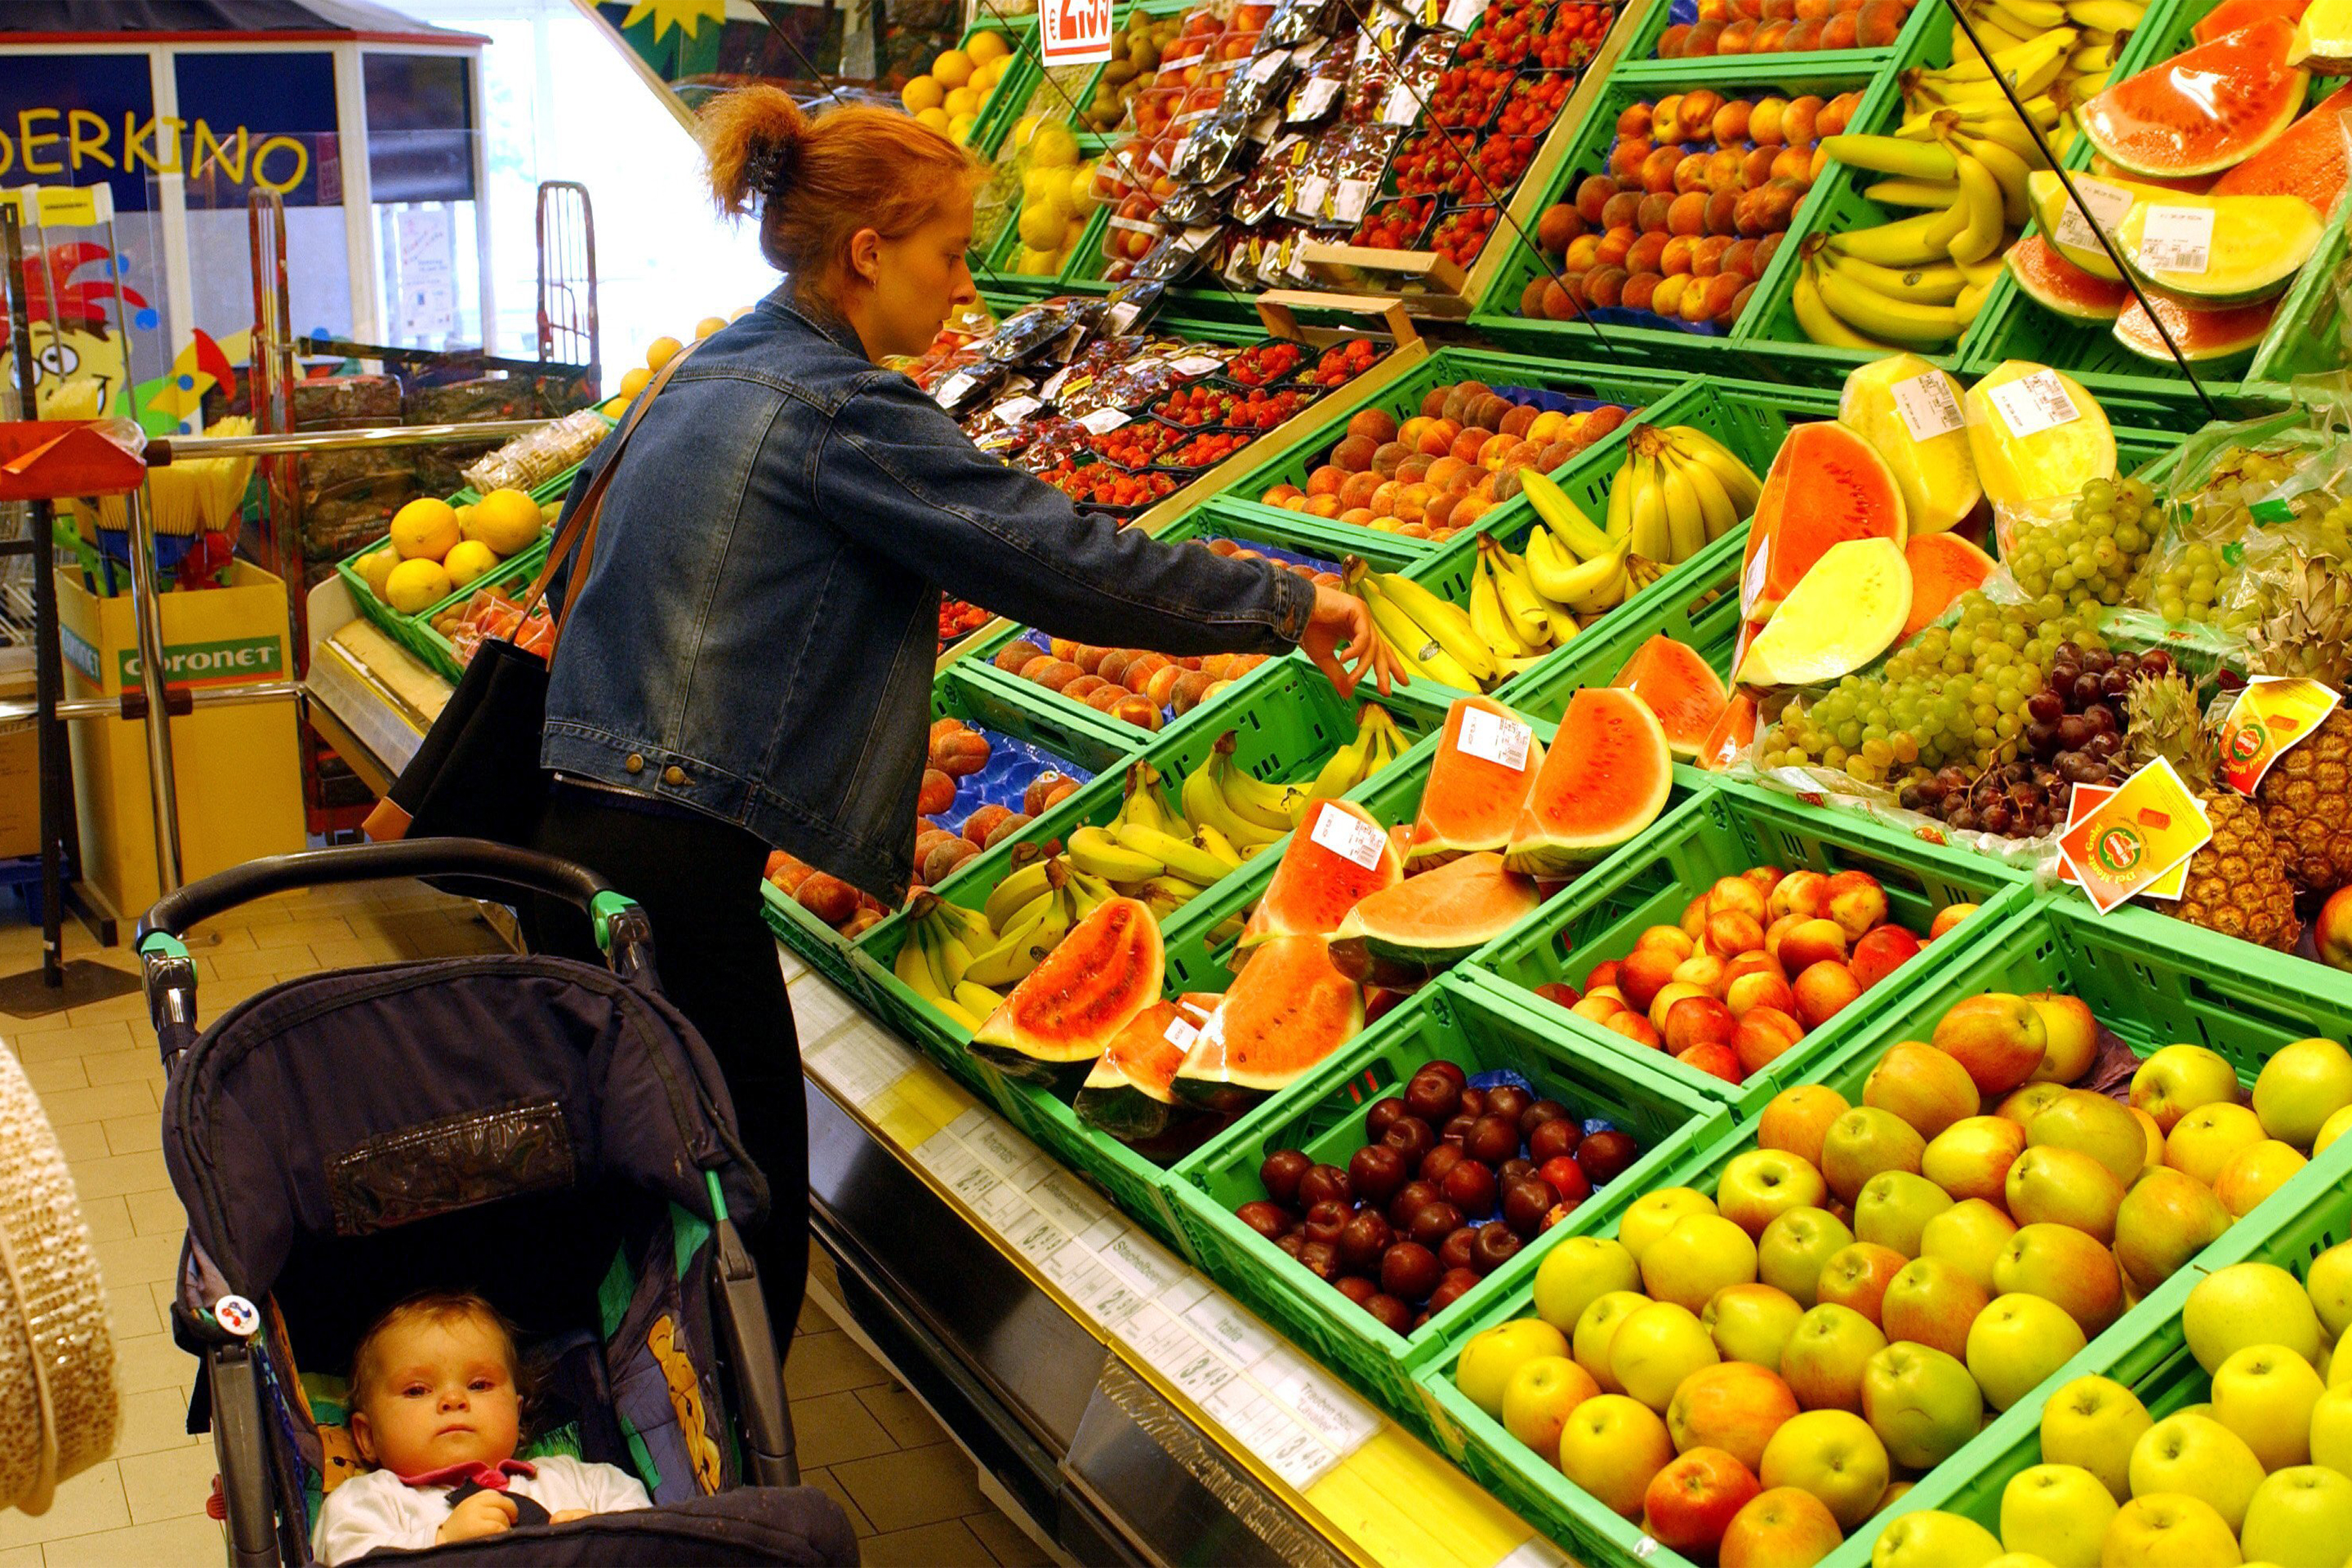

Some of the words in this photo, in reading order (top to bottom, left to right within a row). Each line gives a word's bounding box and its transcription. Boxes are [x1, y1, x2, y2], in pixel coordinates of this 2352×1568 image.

[124, 646, 274, 677] cronet
[2085, 822, 2105, 851] Gold
[2087, 853, 2112, 884] Monte
[2115, 871, 2136, 884] Del
[983, 1131, 1018, 1165] Ananas
[1215, 1317, 1243, 1343] Italia
[1301, 1382, 1336, 1414] Trauben
[1276, 1436, 1327, 1469] 3.49
